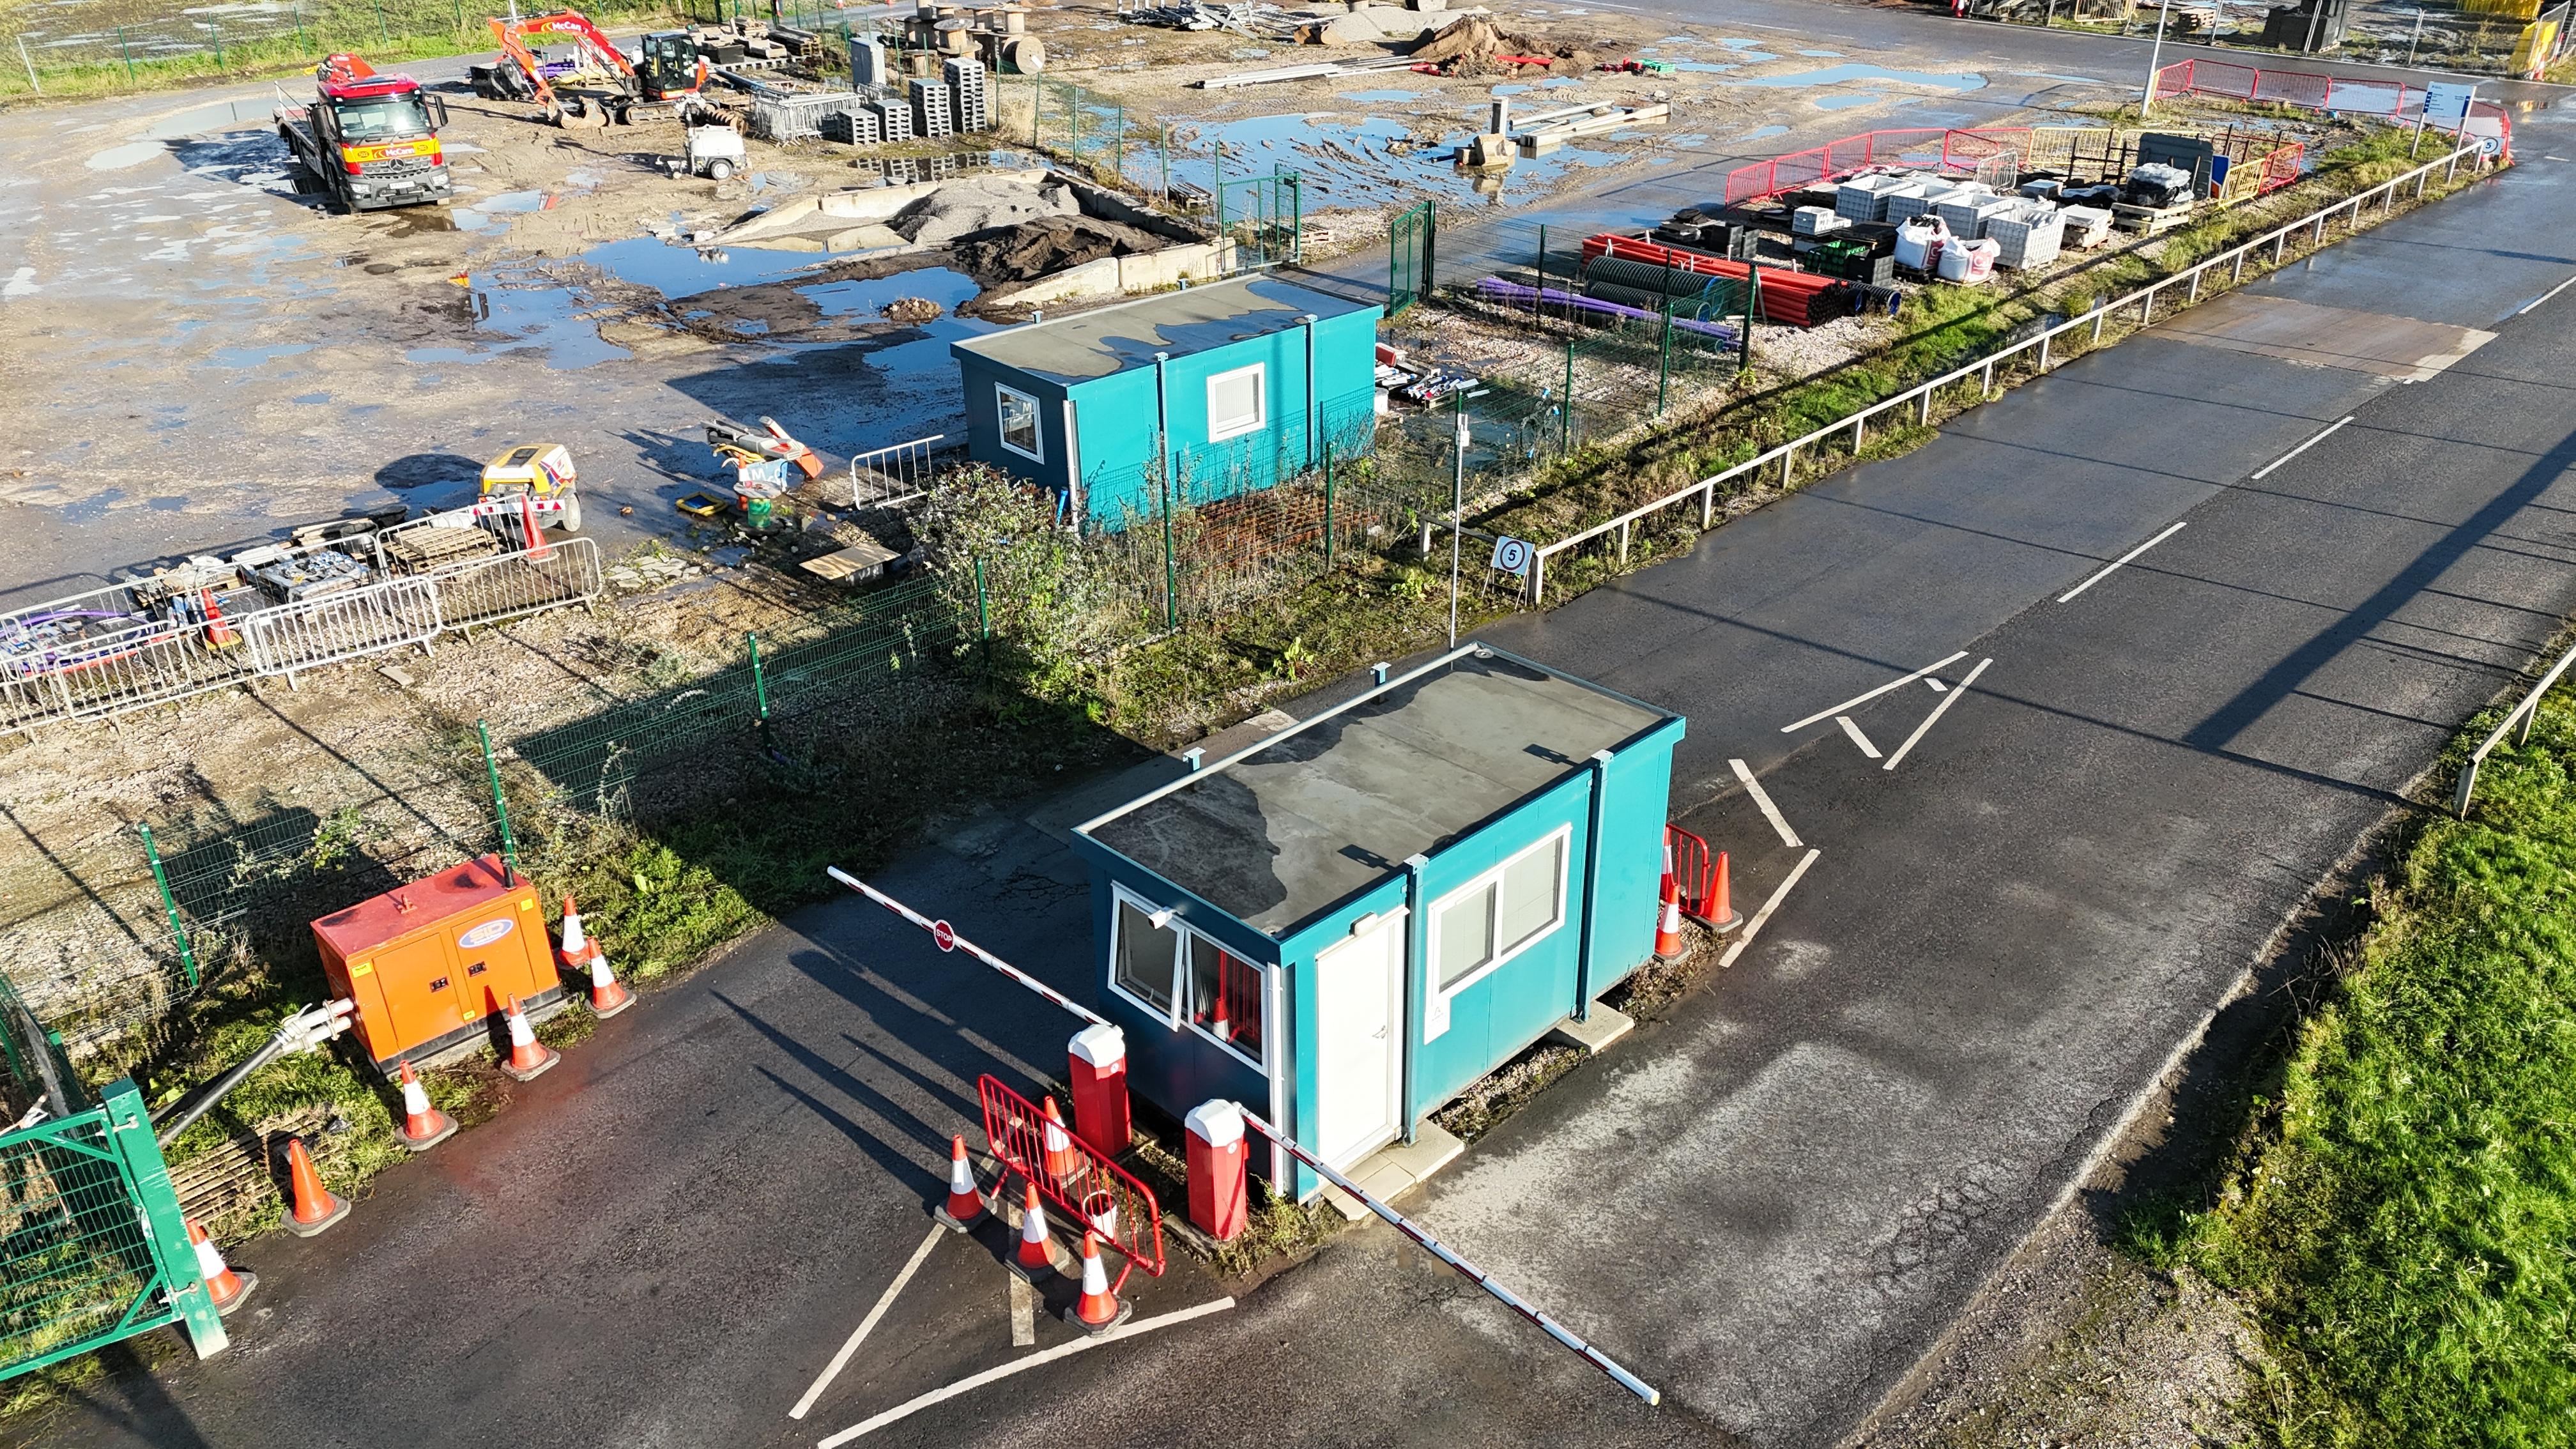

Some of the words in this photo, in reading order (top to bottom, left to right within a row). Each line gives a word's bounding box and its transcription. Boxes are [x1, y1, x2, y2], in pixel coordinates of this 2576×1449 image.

[385, 148, 415, 157] McCann
[1508, 549, 1517, 562] 5
[936, 928, 953, 942] STOP
